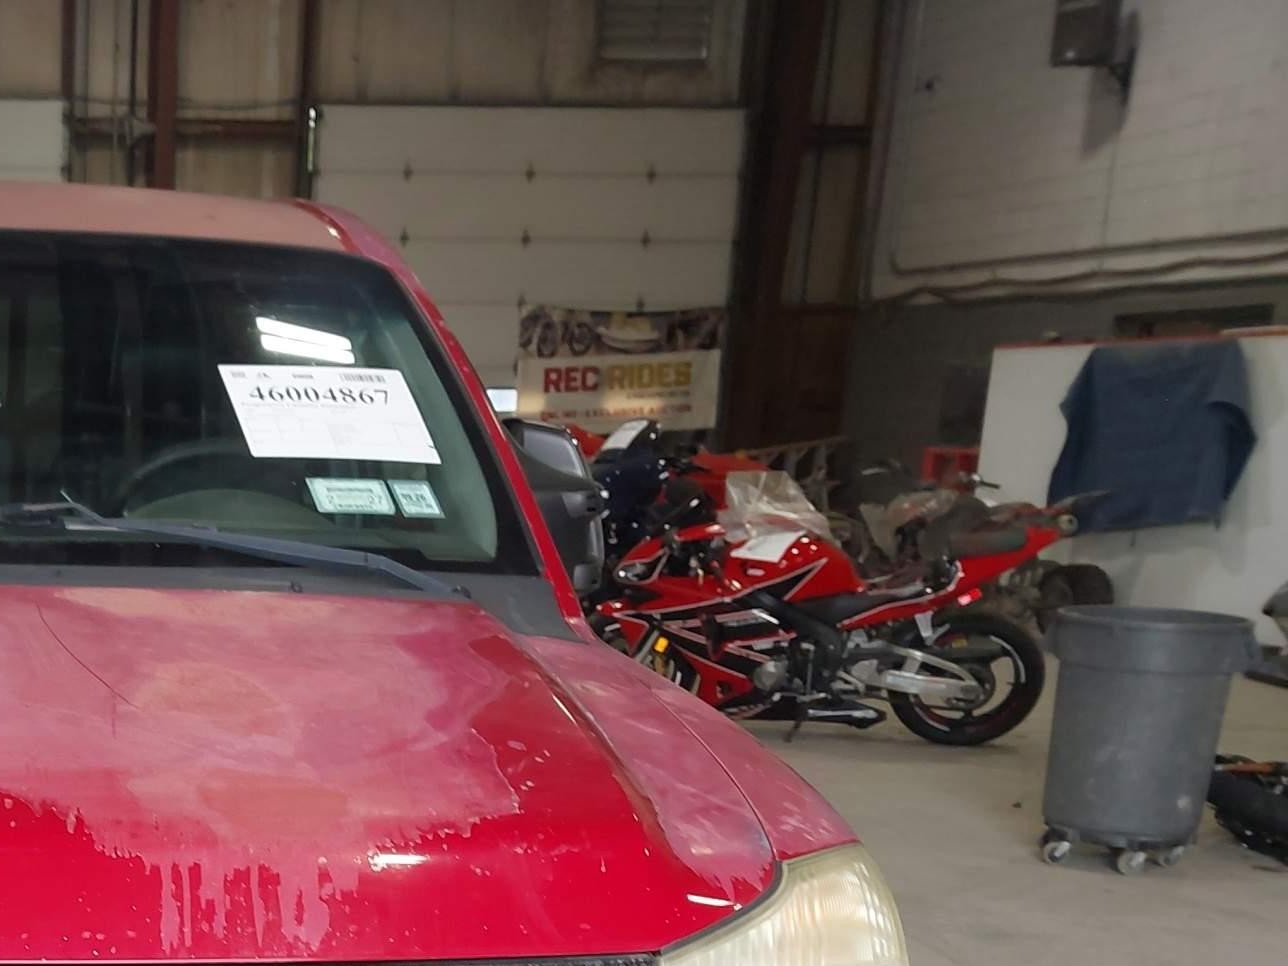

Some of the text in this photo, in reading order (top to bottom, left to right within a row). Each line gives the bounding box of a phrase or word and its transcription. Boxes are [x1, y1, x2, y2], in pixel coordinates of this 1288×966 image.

[544, 362, 693, 393] REC RIDES
[248, 384, 390, 405] 46004867
